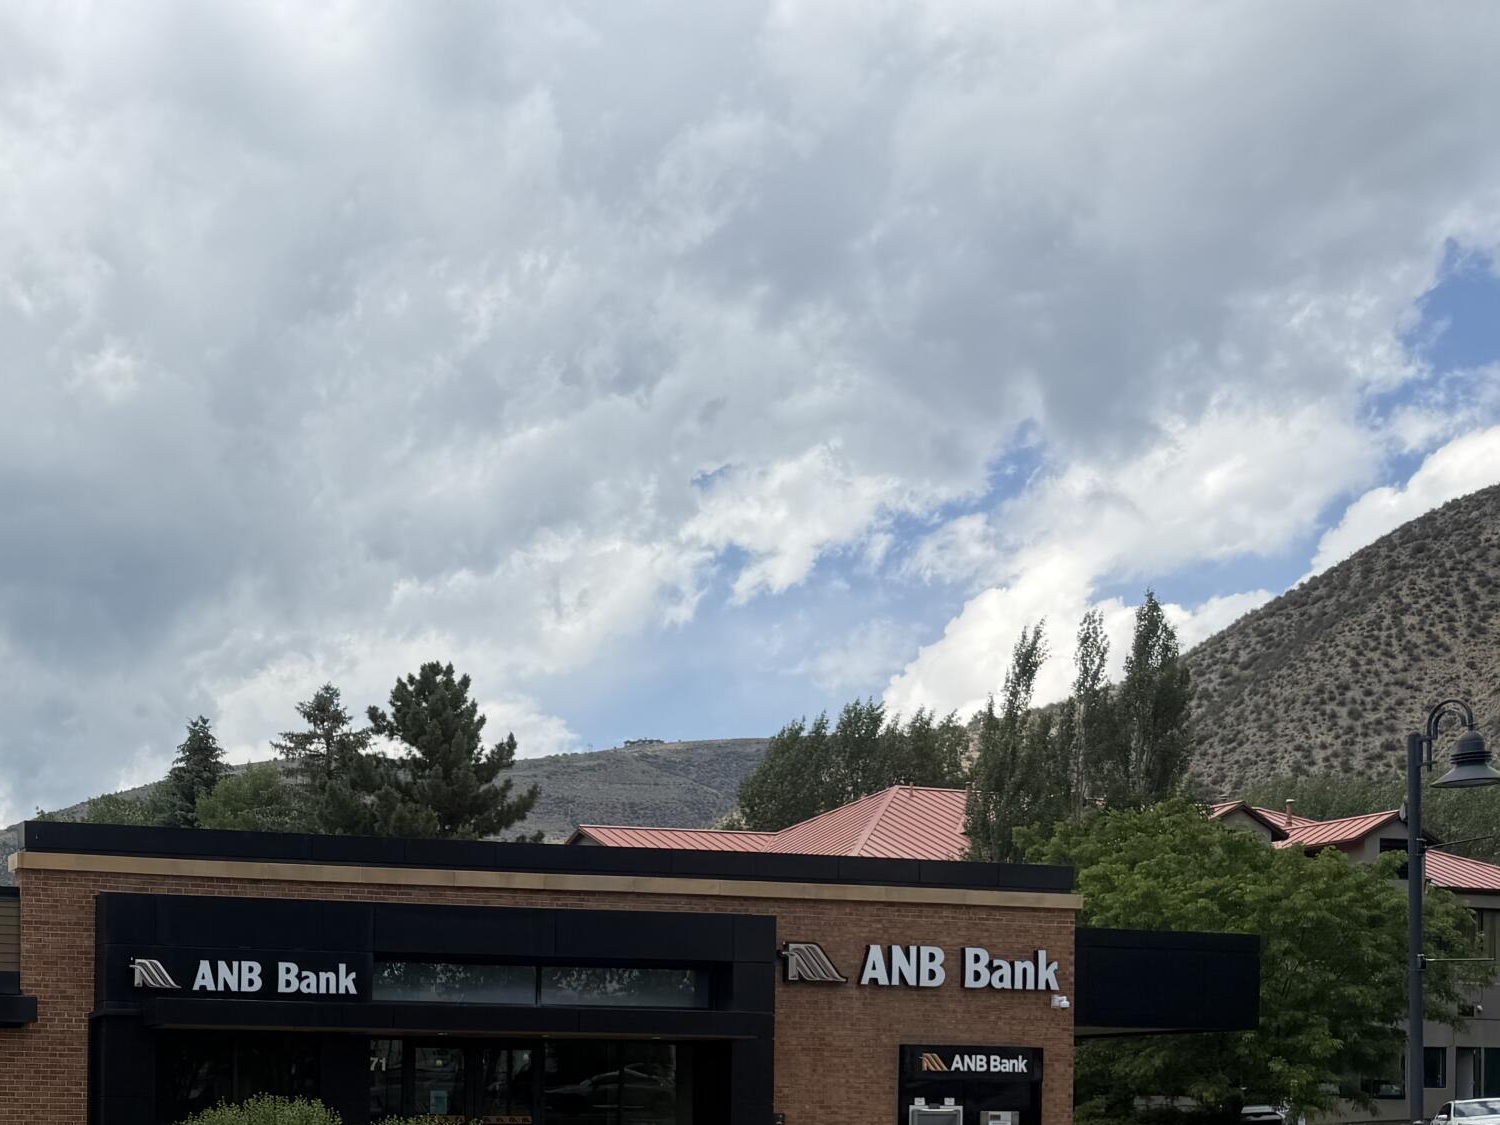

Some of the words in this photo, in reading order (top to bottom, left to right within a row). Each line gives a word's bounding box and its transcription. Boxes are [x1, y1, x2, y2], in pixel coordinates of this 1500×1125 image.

[192, 959, 263, 993] ANB
[277, 961, 358, 995] Bank
[860, 944, 946, 988] ANB
[964, 946, 1060, 990] Bank
[369, 1057, 387, 1072] 71
[950, 1054, 988, 1072] ANB
[989, 1055, 1029, 1073] Bank
